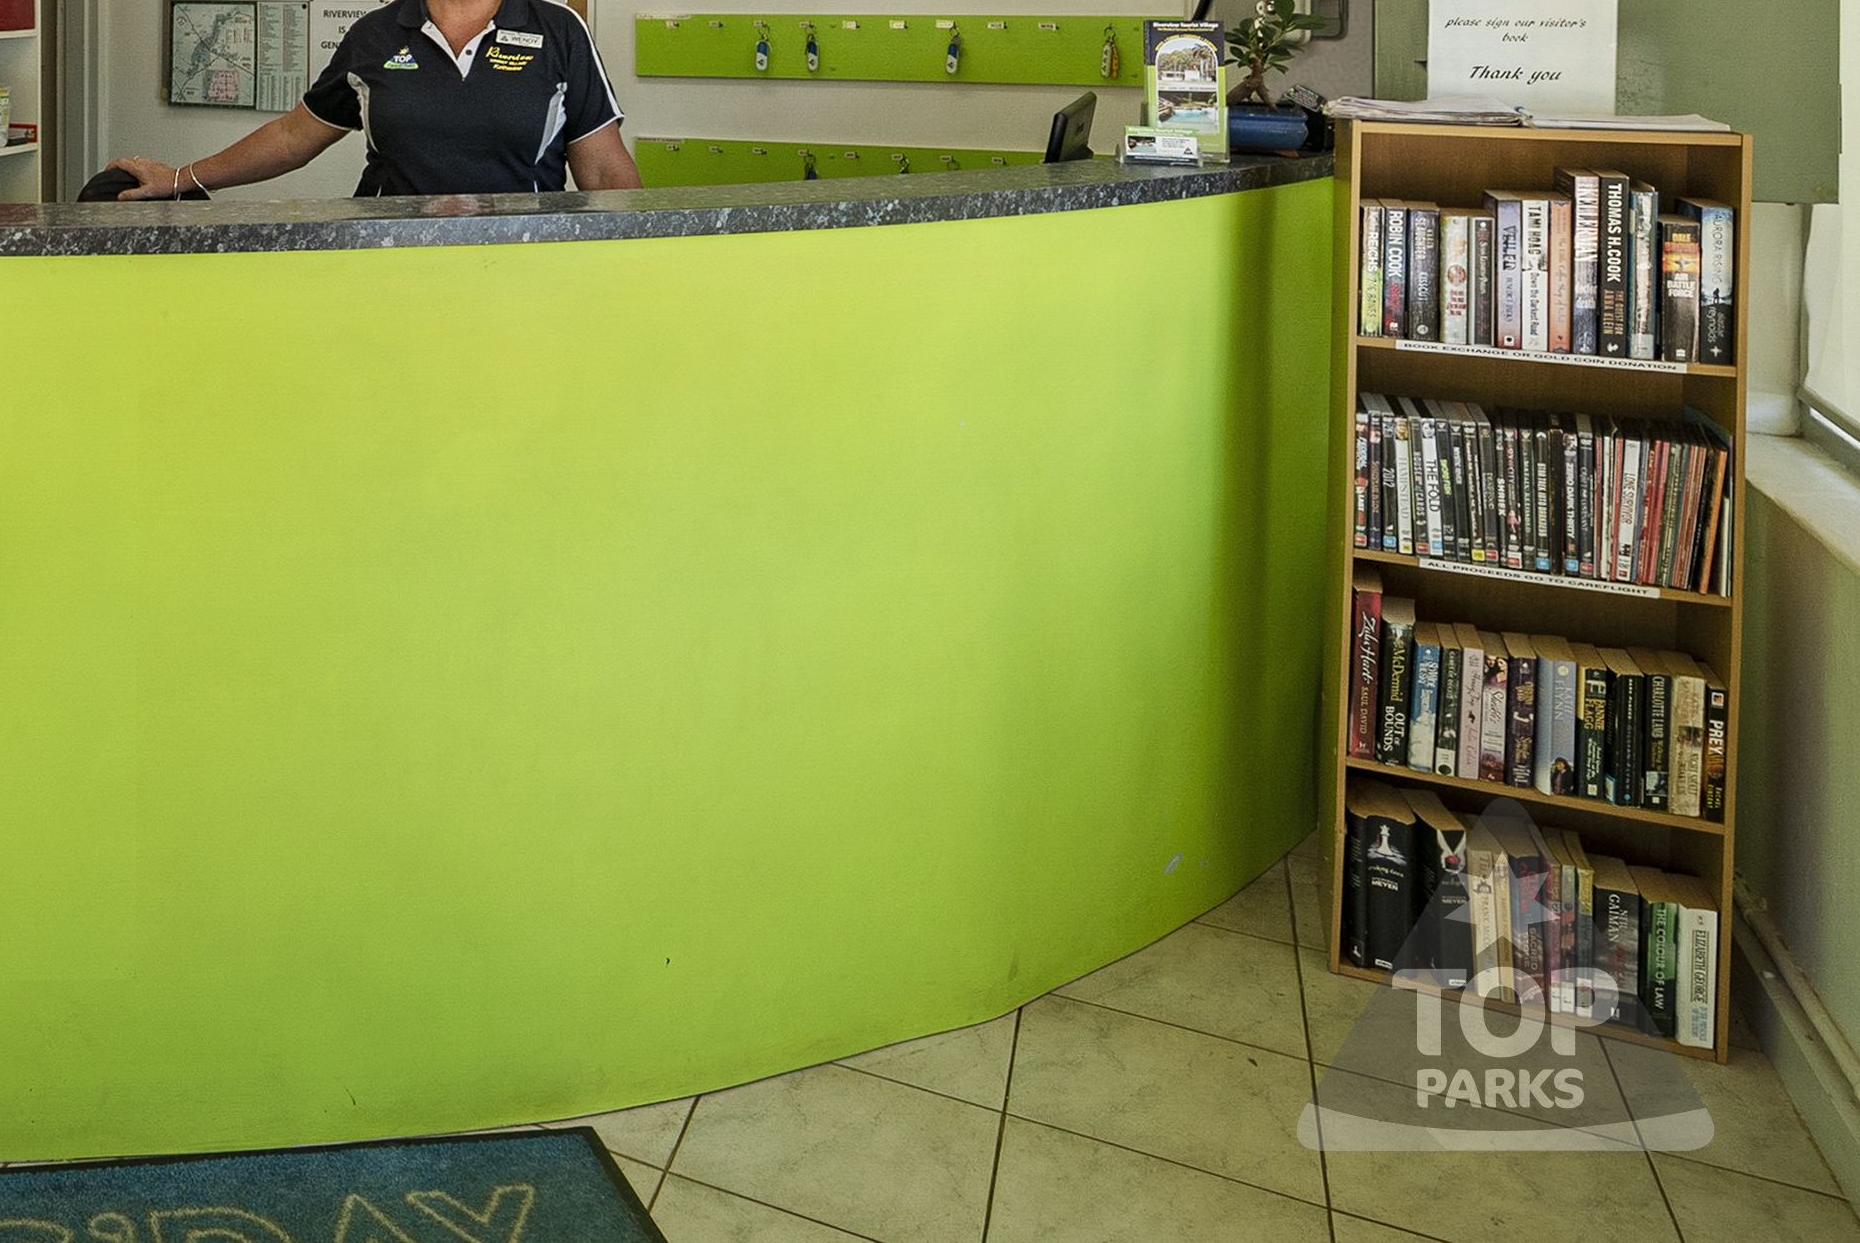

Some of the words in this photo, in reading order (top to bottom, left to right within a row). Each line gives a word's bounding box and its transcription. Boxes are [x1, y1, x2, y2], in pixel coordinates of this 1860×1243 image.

[1444, 17, 1481, 29] please
[1486, 18, 1510, 29] sign
[1515, 19, 1535, 28] our
[1540, 18, 1586, 28] visitor's
[1502, 32, 1529, 42] book
[393, 54, 413, 63] TOP
[1469, 65, 1523, 80] Thank
[1527, 69, 1562, 85] you
[1607, 184, 1622, 234] THOMAS
[1389, 211, 1403, 244] ROBIN
[1368, 233, 1378, 272] REICHS
[1389, 245, 1402, 277] COOK
[1607, 236, 1621, 283] H.COOK
[1667, 281, 1695, 289] BATTLE
[1668, 289, 1694, 297] FORCE
[1442, 345, 1508, 357] EXCHANGE
[1534, 353, 1570, 362] GOLD
[1574, 356, 1606, 365] COIN
[1609, 360, 1677, 371] DONATION
[1383, 468, 1395, 488] 2012
[1497, 478, 1506, 516] SHREK
[1453, 564, 1521, 579] PROCEEDS
[1546, 575, 1565, 584] TO
[1568, 578, 1650, 597] CAREFLIGHT
[1383, 706, 1395, 751] BOUNDS
[1394, 712, 1405, 737] OUT
[1709, 720, 1724, 755] PREY
[1371, 879, 1399, 891] MEYER
[1608, 894, 1620, 942] GAIMAN
[1656, 909, 1667, 925] THE
[1656, 927, 1667, 971] COLOUR
[1655, 972, 1665, 988] OF
[1654, 989, 1664, 1009] LAW
